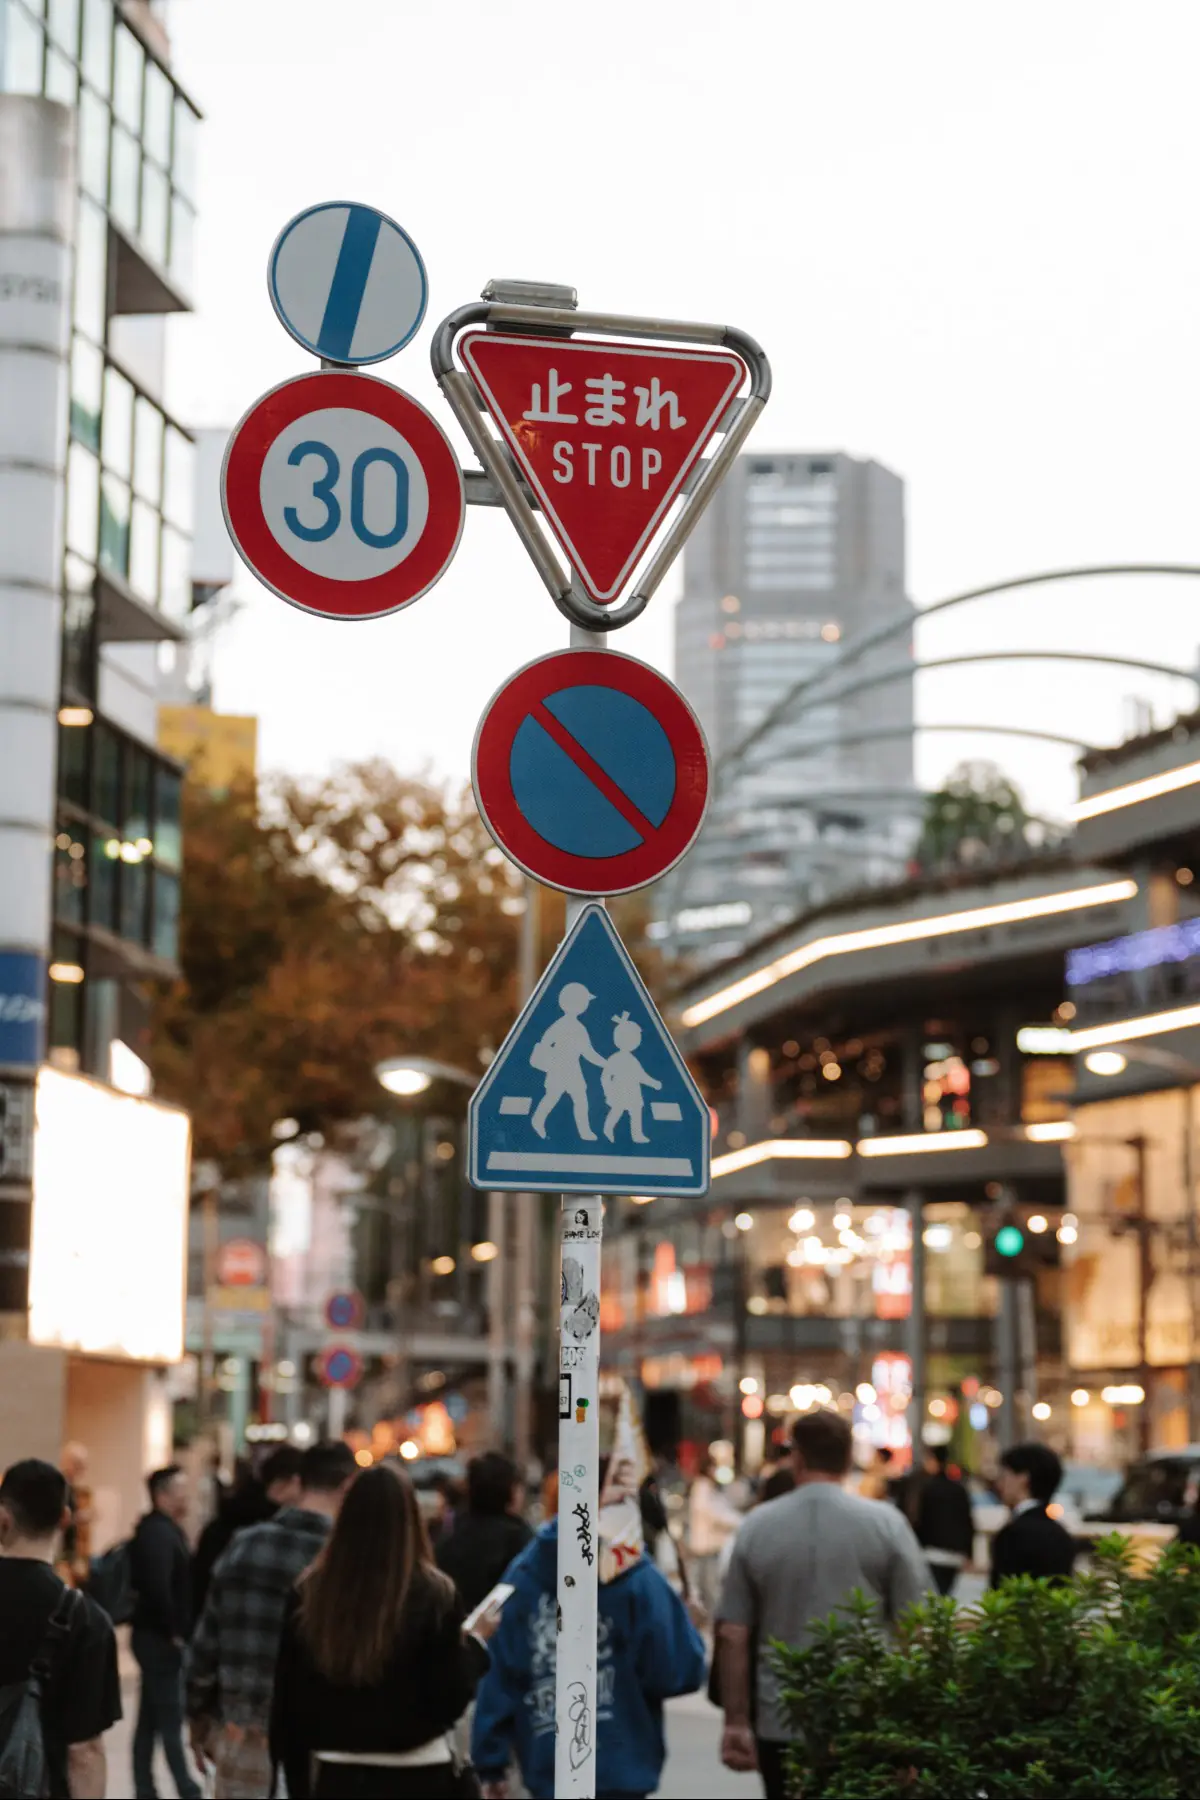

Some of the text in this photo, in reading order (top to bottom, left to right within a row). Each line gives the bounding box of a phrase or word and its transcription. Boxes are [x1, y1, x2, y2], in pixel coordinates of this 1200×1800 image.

[522, 368, 687, 431] 止まれ
[283, 440, 410, 549] 30
[552, 440, 662, 490] STOP
